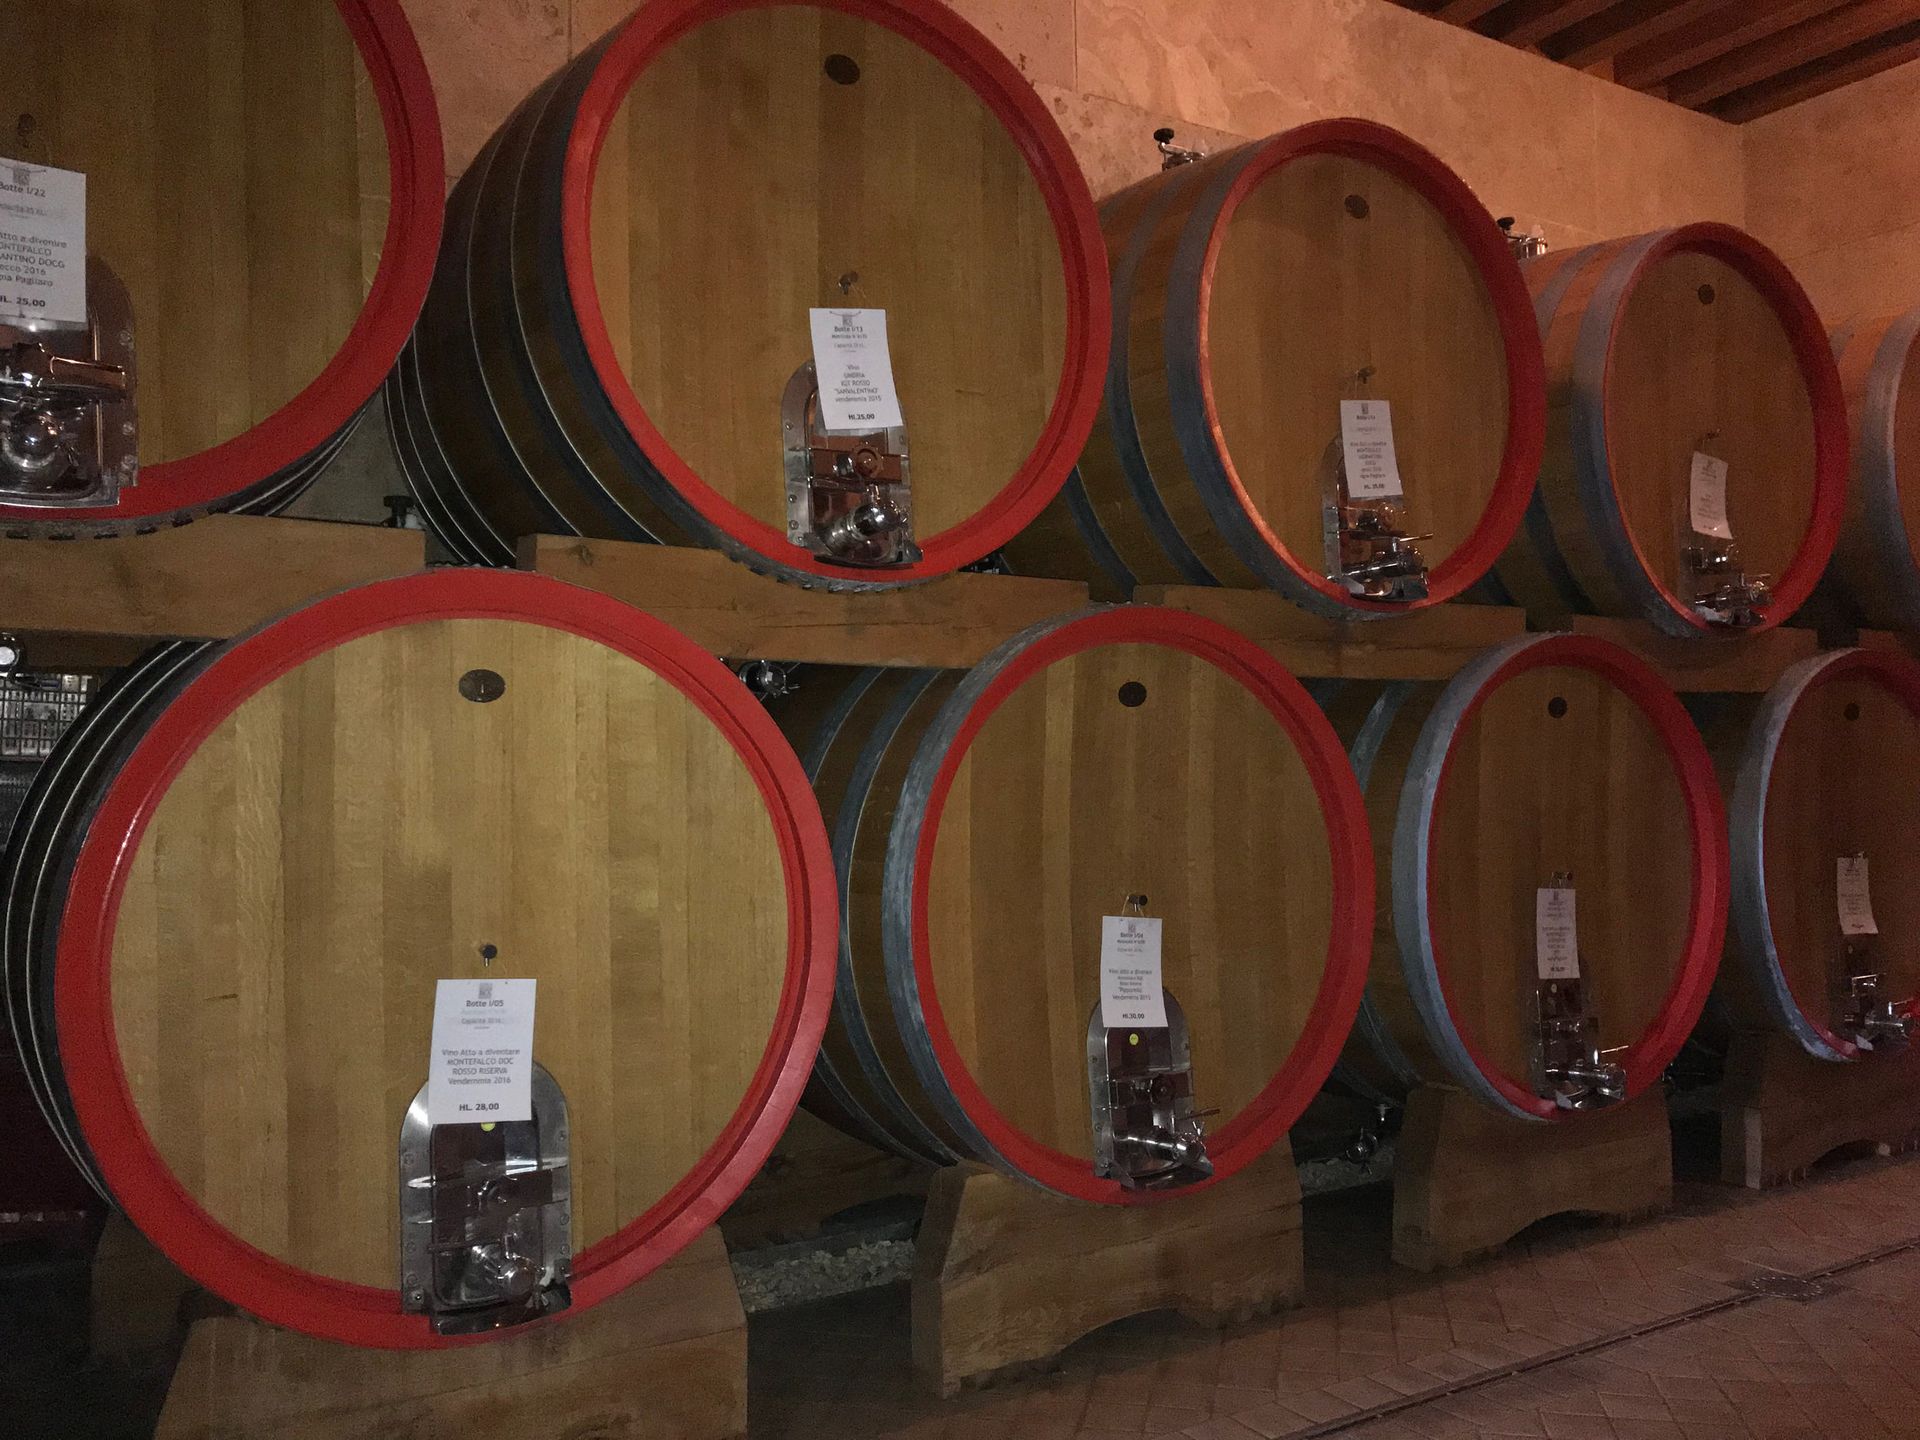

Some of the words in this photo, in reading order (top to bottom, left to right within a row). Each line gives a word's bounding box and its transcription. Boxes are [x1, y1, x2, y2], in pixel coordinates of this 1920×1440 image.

[38, 258, 66, 269] DOCG
[24, 266, 46, 276] 2016
[16, 296, 46, 308] 25,00
[466, 999, 487, 1008] Botte
[447, 1058, 496, 1066] MONTEFALCO
[498, 1057, 514, 1065] DOC
[452, 1067, 478, 1076] ROSSO
[479, 1066, 508, 1075] RISERVA
[494, 1076, 512, 1084] 2016
[475, 1102, 500, 1112] 28,00
